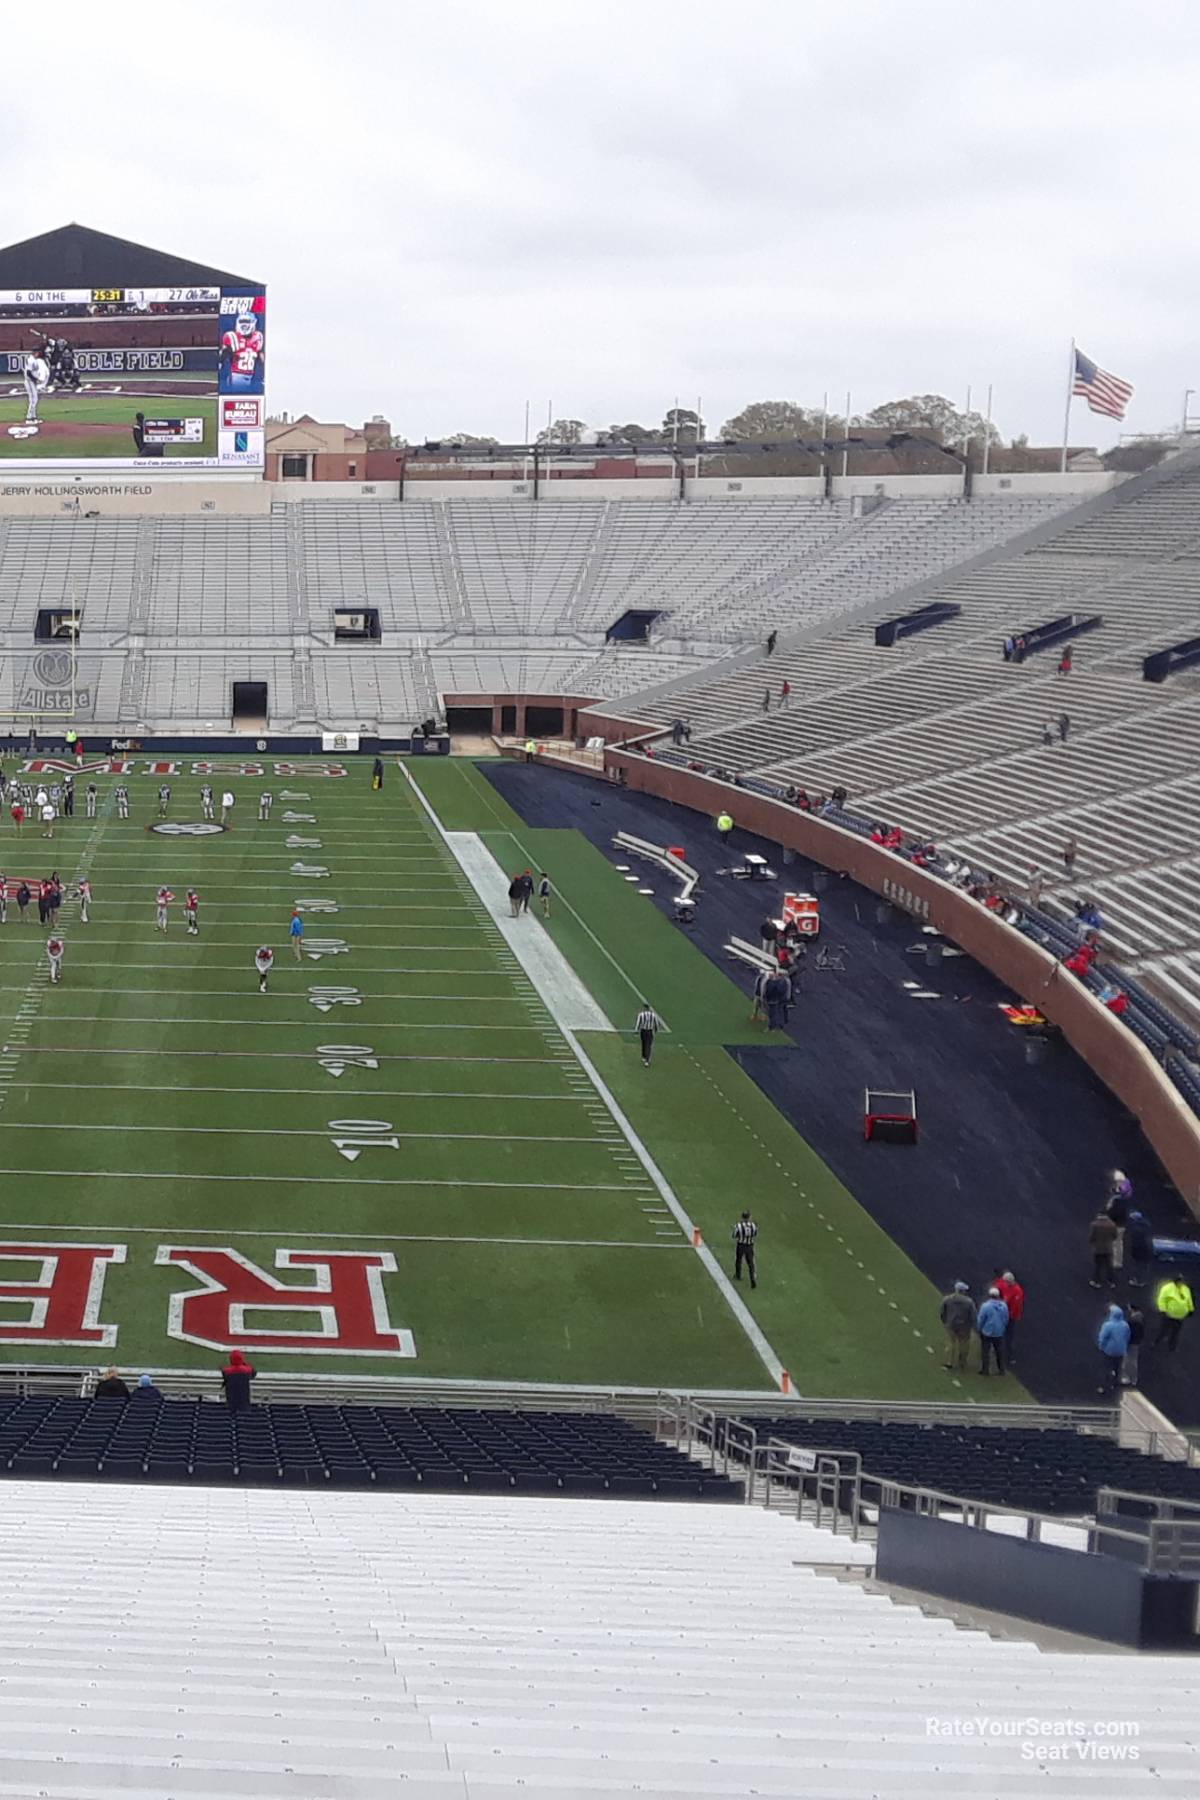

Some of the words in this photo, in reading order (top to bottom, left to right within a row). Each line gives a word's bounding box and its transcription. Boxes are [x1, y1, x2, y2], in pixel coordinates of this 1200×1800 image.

[28, 292, 43, 301] ON
[47, 291, 66, 301] THE
[93, 290, 121, 300] 25:31
[169, 290, 182, 300] 27
[77, 352, 124, 370] OBLE
[127, 351, 184, 370] FIELD
[1, 486, 31, 496] JERRY
[34, 486, 121, 496] HOLLINGSWORTH
[124, 486, 152, 495] FIELD
[24, 690, 89, 709] Allstate
[112, 740, 141, 750] FedEx
[16, 759, 348, 777] MISS
[801, 919, 813, 931] G
[307, 985, 363, 1006] 30
[315, 1044, 380, 1070] 20
[326, 1118, 401, 1150] 10
